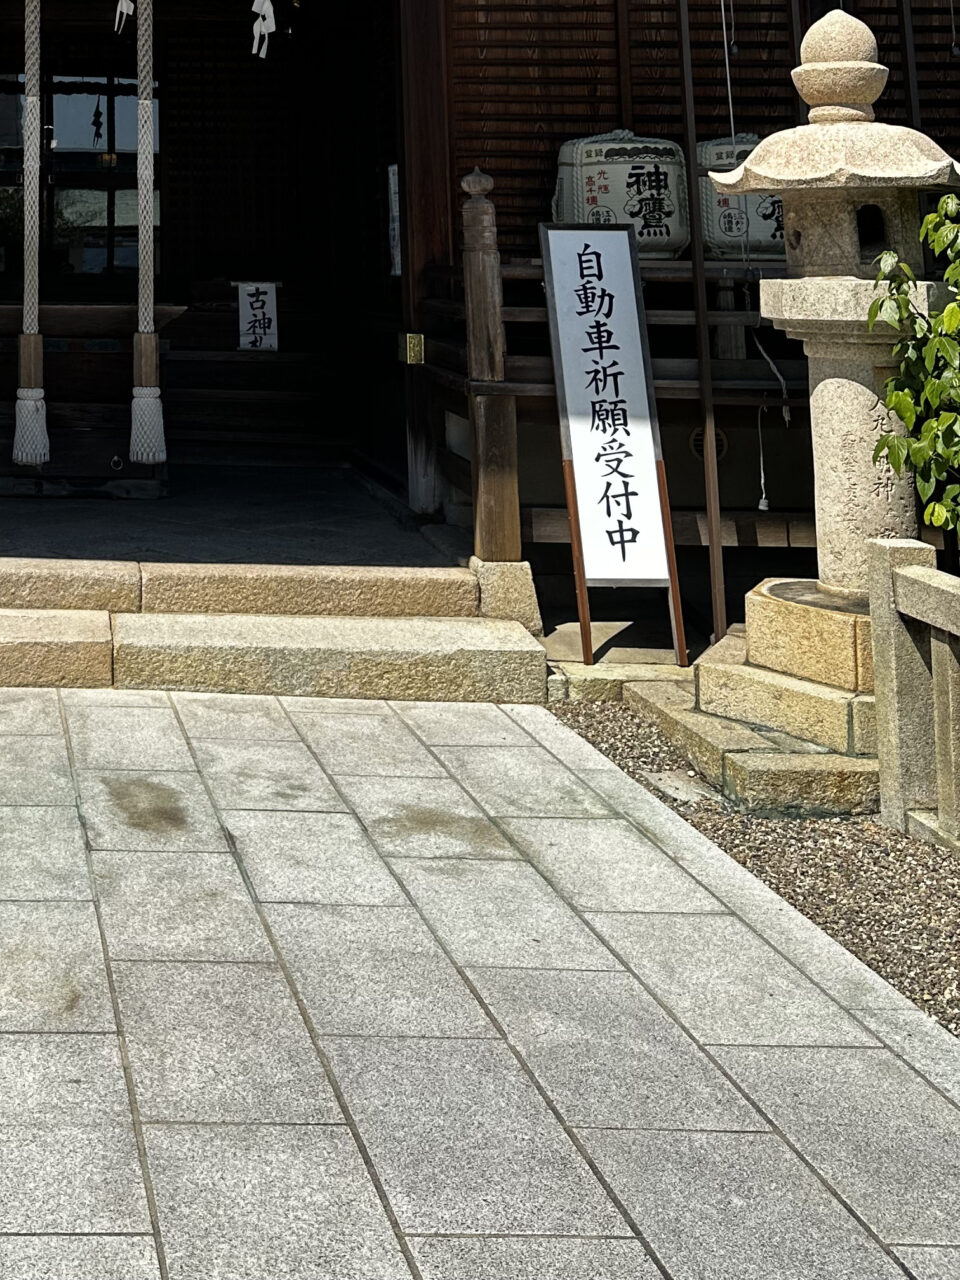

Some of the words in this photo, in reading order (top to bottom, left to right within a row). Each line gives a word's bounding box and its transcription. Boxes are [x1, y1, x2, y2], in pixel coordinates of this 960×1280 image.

[626, 164, 672, 237] 神鷹
[573, 243, 641, 562] 自動車祈願受付中
